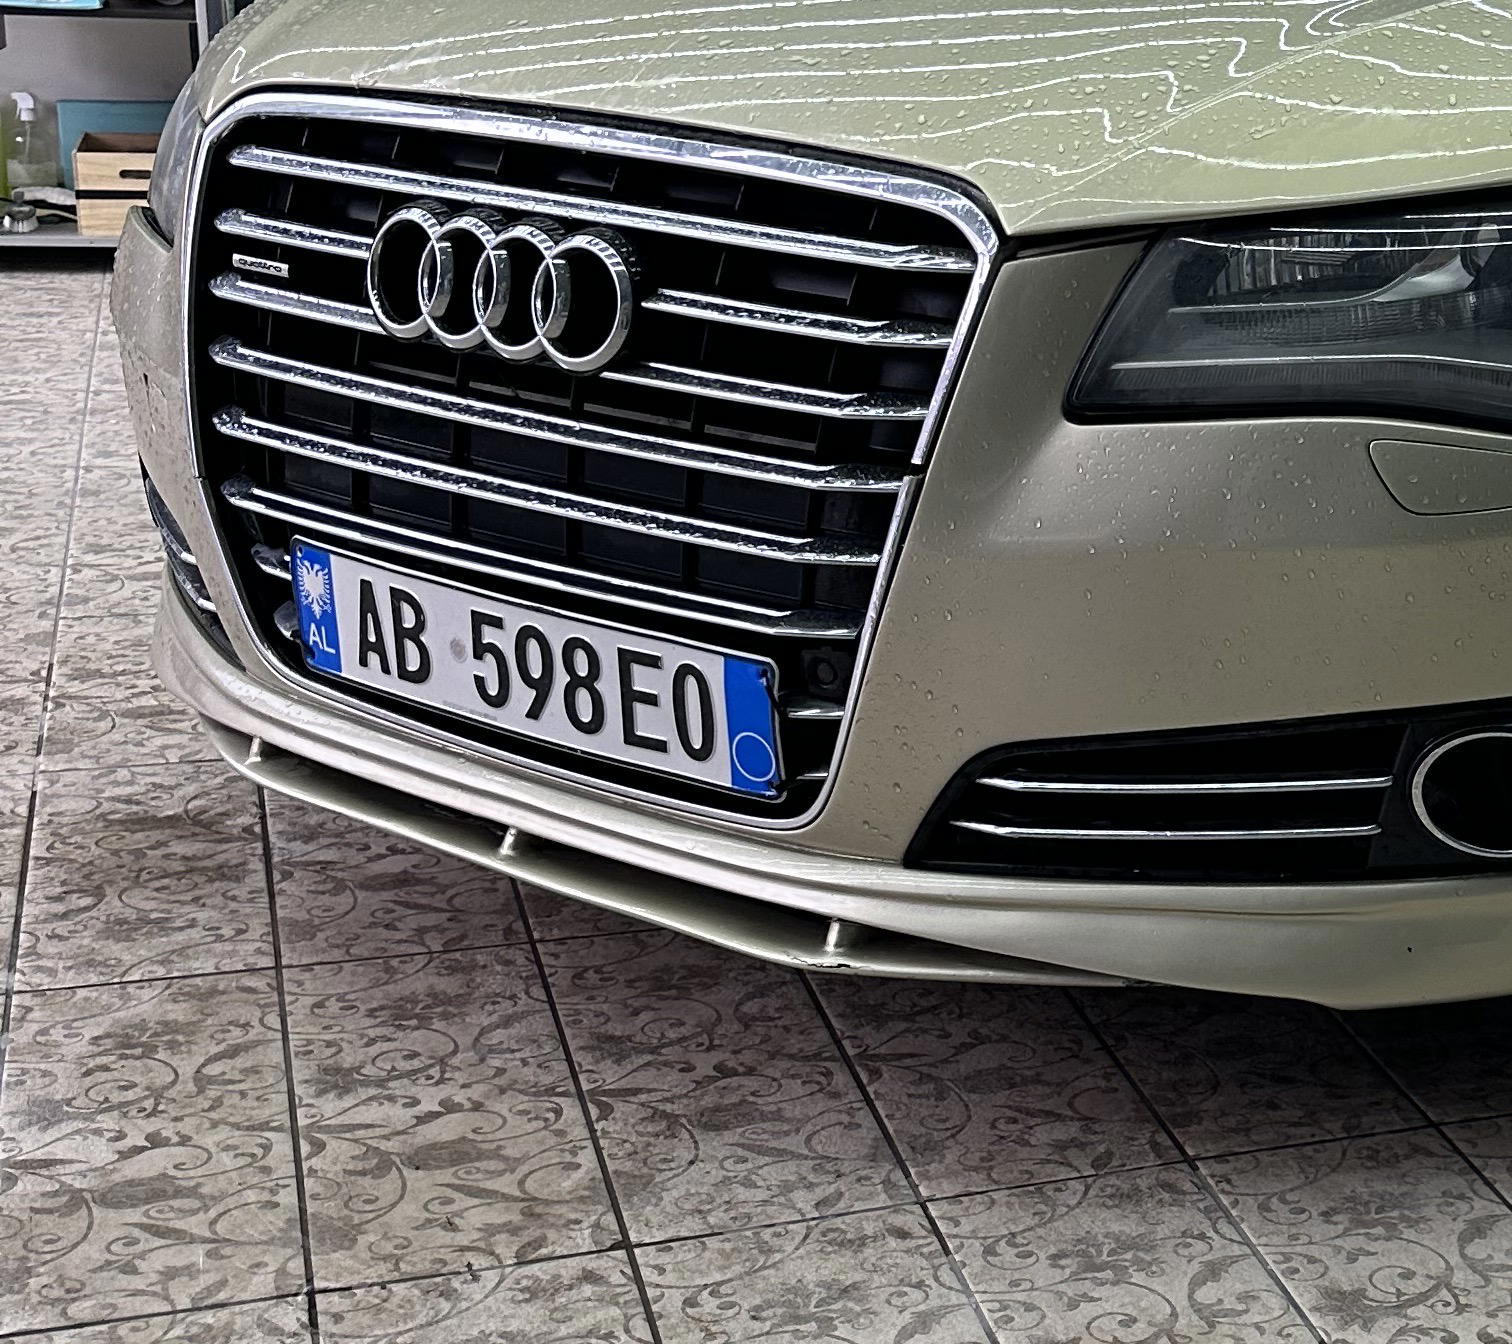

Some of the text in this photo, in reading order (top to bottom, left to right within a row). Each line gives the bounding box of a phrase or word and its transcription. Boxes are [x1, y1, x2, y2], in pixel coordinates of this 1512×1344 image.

[238, 258, 282, 273] quattro
[309, 622, 336, 655] AL
[358, 579, 431, 684] AB
